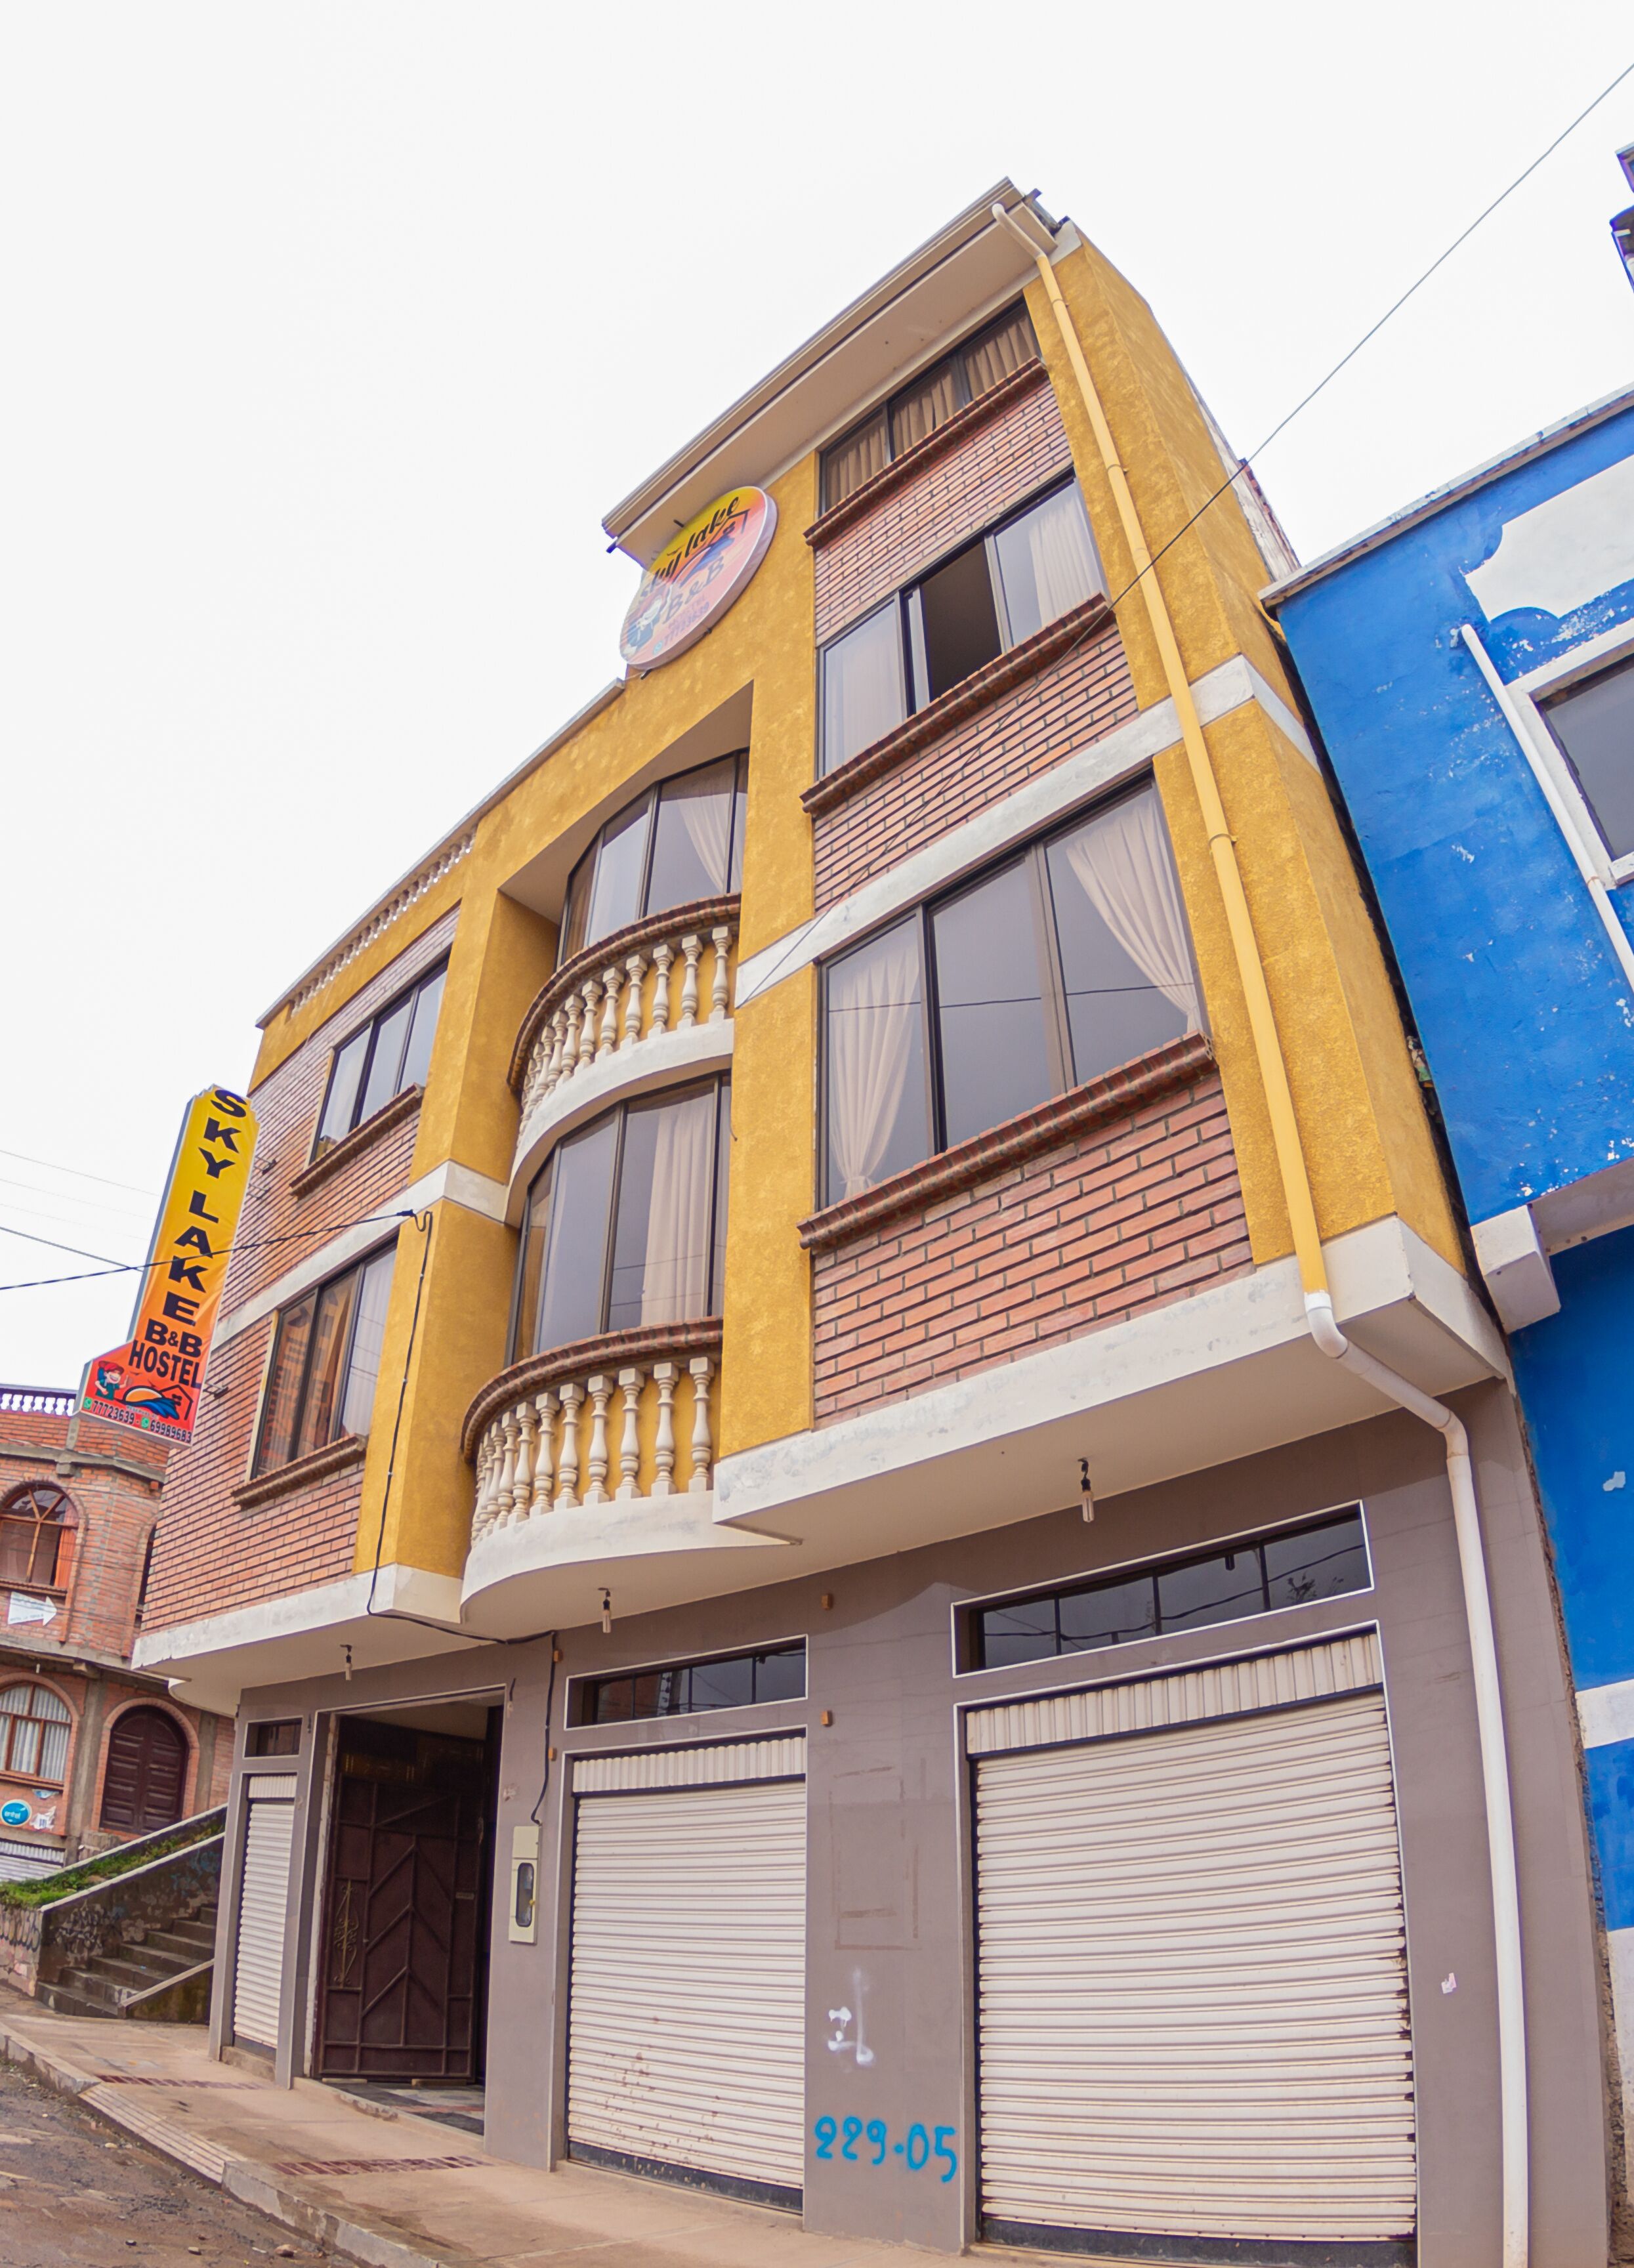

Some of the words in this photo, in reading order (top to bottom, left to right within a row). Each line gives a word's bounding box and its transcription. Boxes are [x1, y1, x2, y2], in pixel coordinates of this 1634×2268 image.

[198, 1089, 247, 1179] SKY
[162, 1190, 219, 1326] LAKE
[144, 1318, 203, 1358] B&B
[128, 1339, 202, 1389] HOSTEL
[93, 1400, 135, 1425] 77723639
[150, 1419, 192, 1443] 69989683
